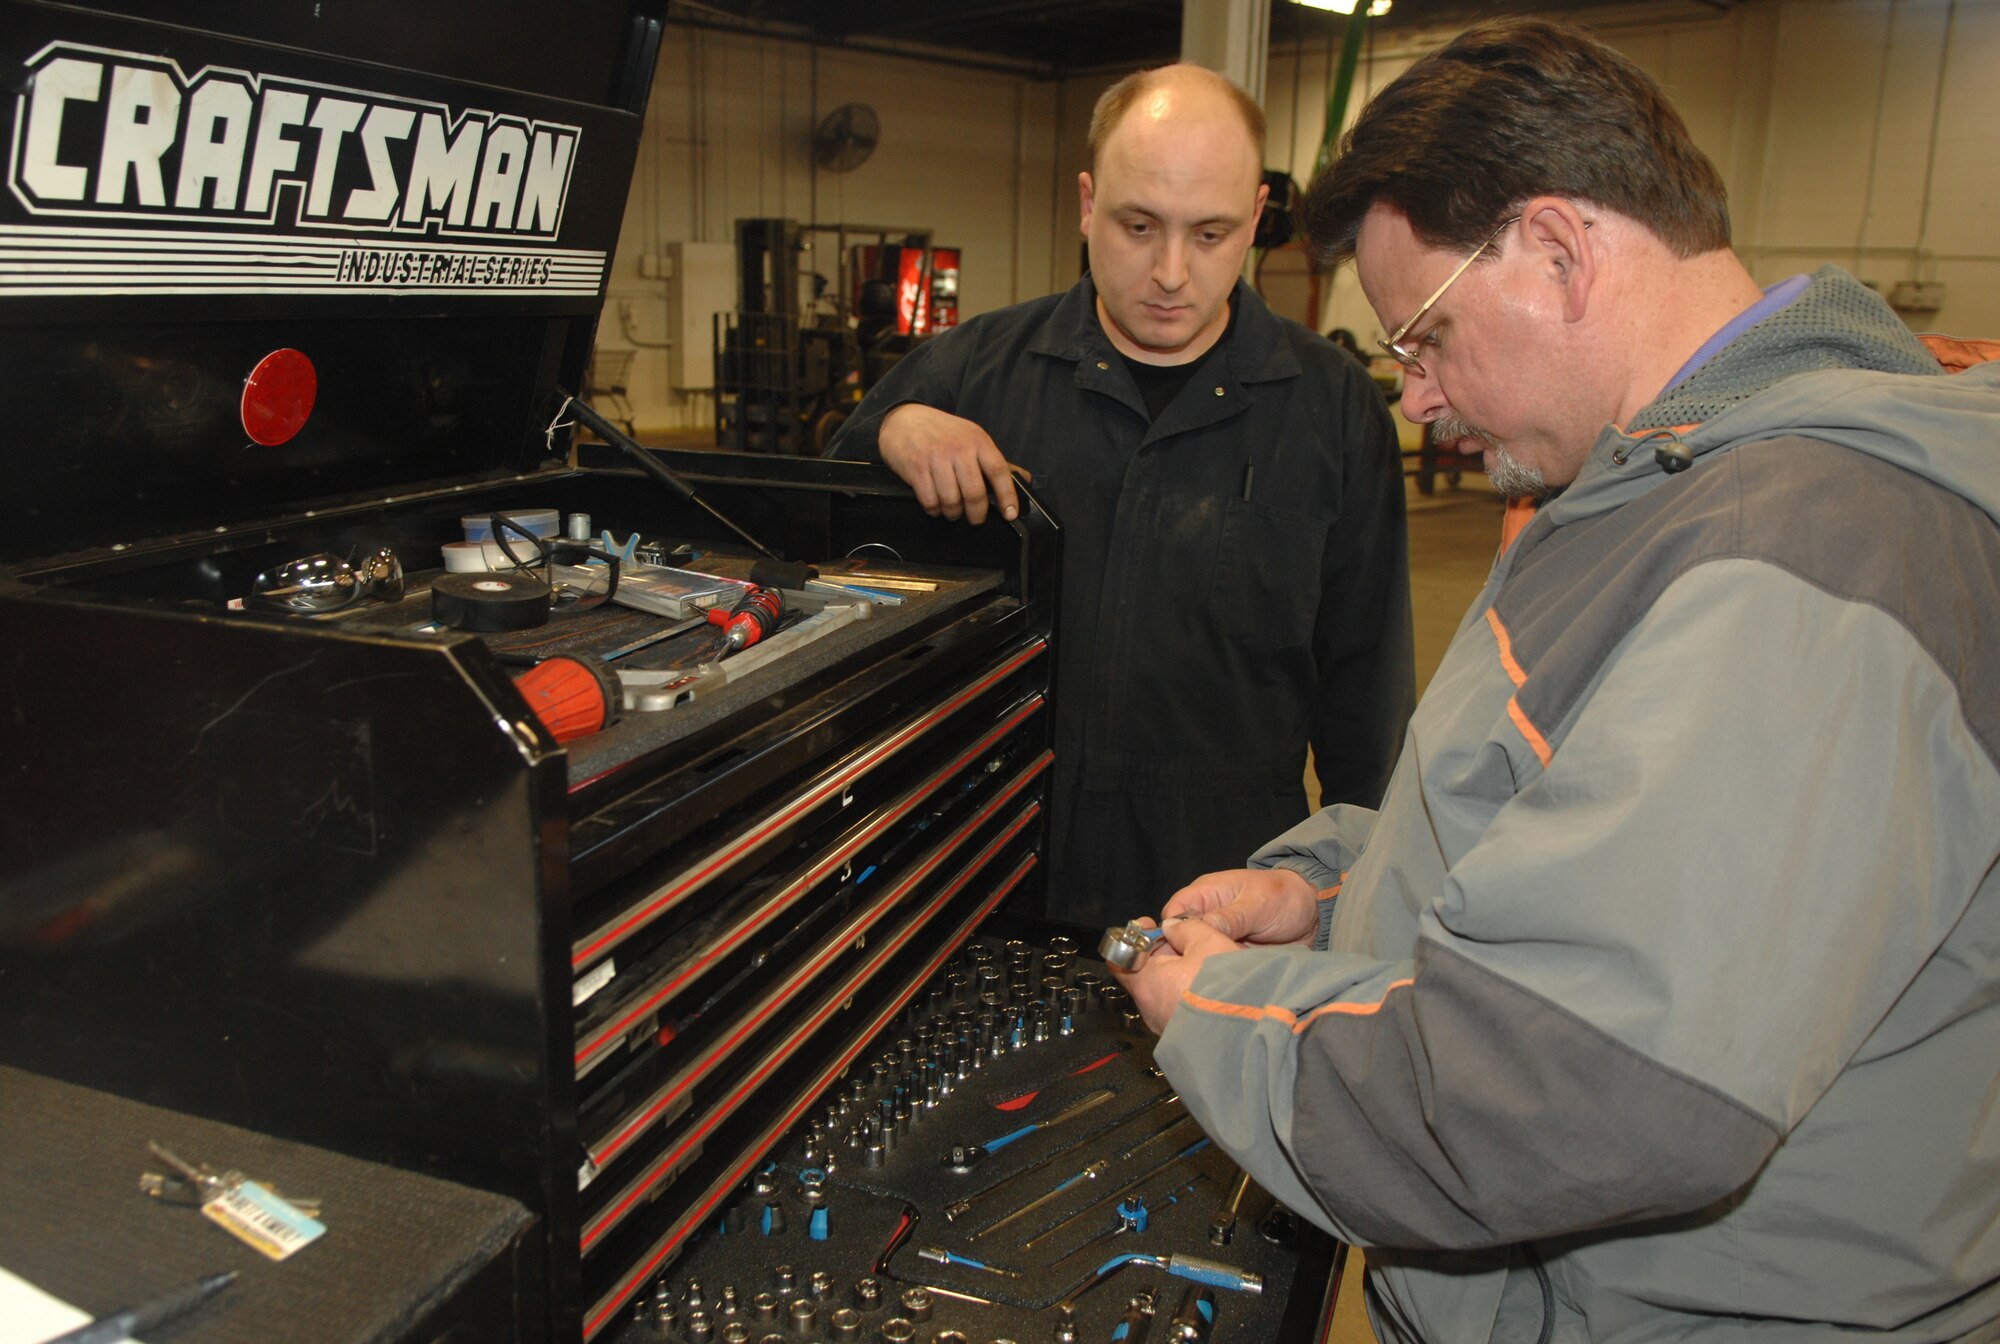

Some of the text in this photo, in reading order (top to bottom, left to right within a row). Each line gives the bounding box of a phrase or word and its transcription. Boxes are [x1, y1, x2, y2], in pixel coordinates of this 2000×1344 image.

[22, 57, 575, 232] CRAFTSMAN
[336, 250, 553, 285] INDUSTRIAL SERIES
